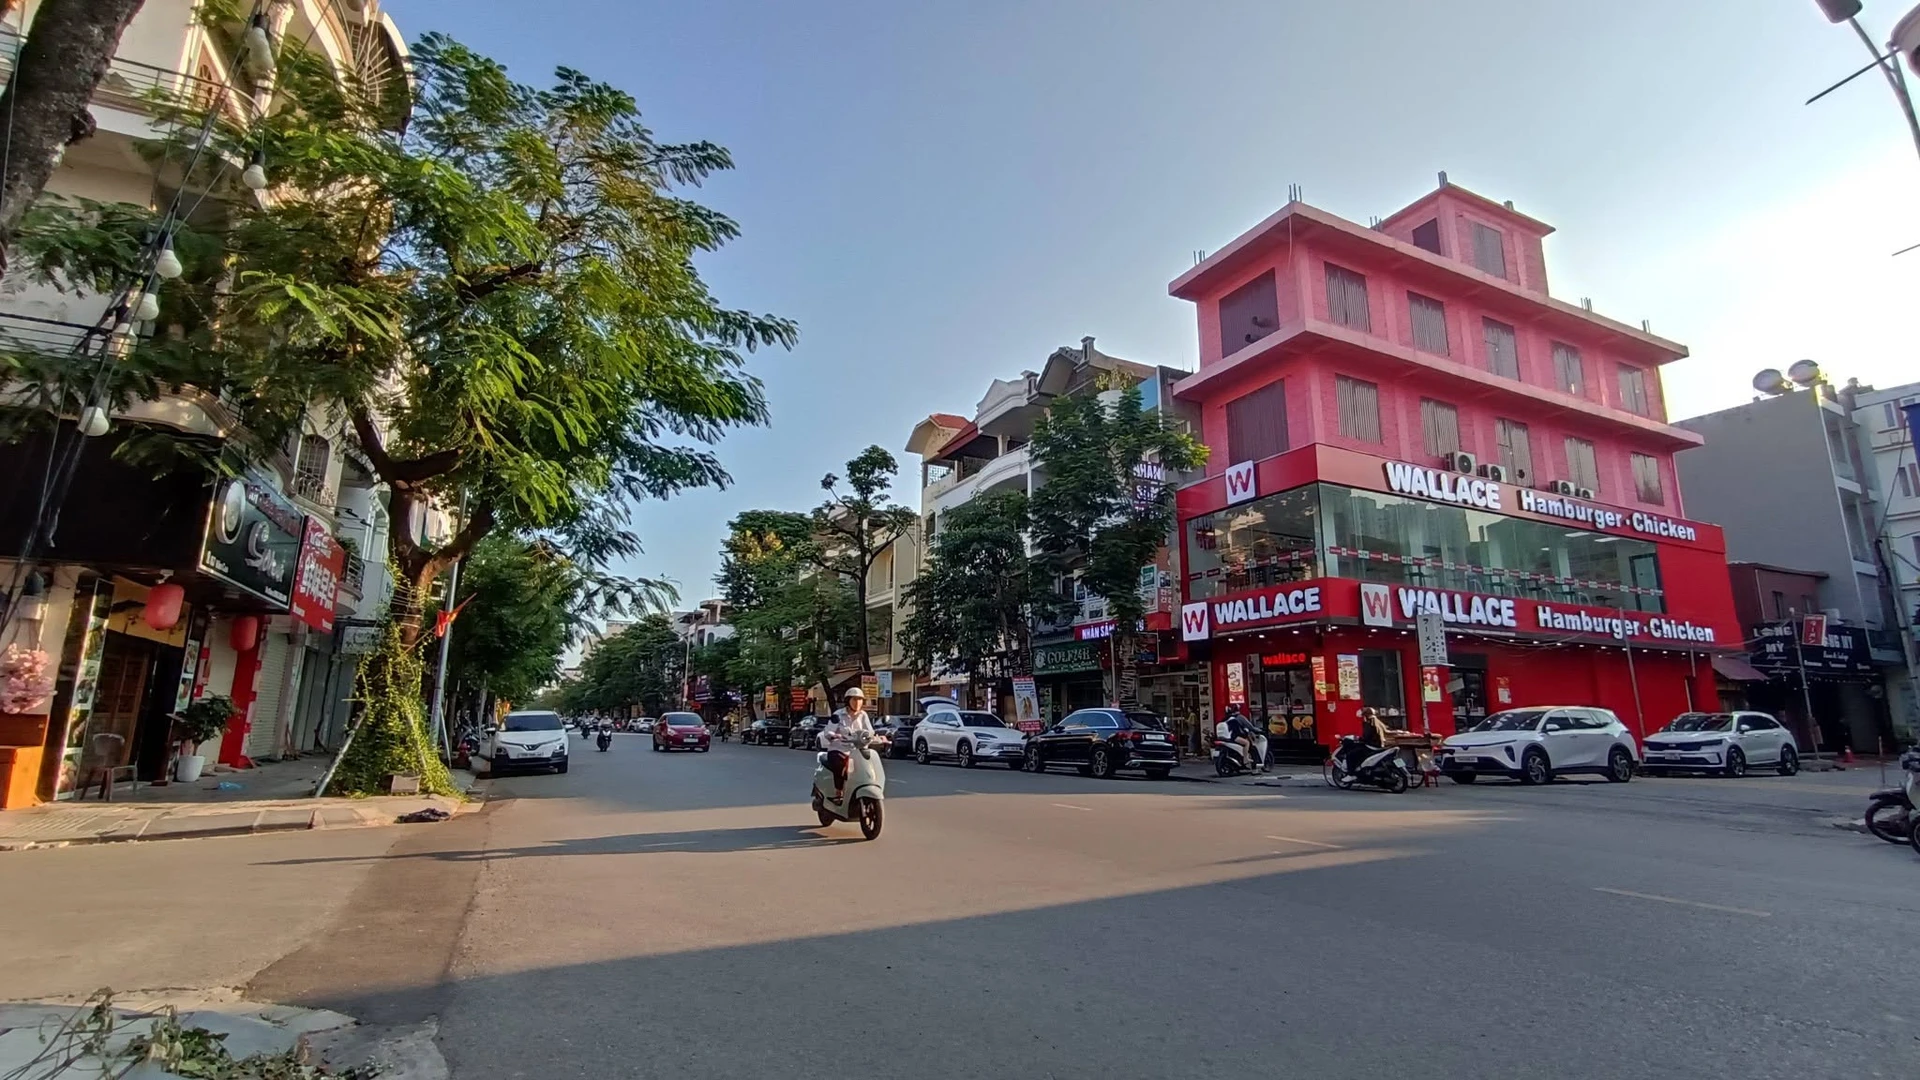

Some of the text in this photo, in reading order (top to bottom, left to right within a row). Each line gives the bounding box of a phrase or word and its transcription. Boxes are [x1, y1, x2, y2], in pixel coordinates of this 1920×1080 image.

[1228, 468, 1251, 496] W
[1386, 462, 1501, 509] WALLACE
[1521, 489, 1696, 541] Hamburger Chicken
[1184, 587, 1321, 634] W WALLACE
[1364, 587, 1517, 627] W WALLACE
[1537, 605, 1715, 642] Hamburger Chicken
[1262, 652, 1306, 666] wallace
